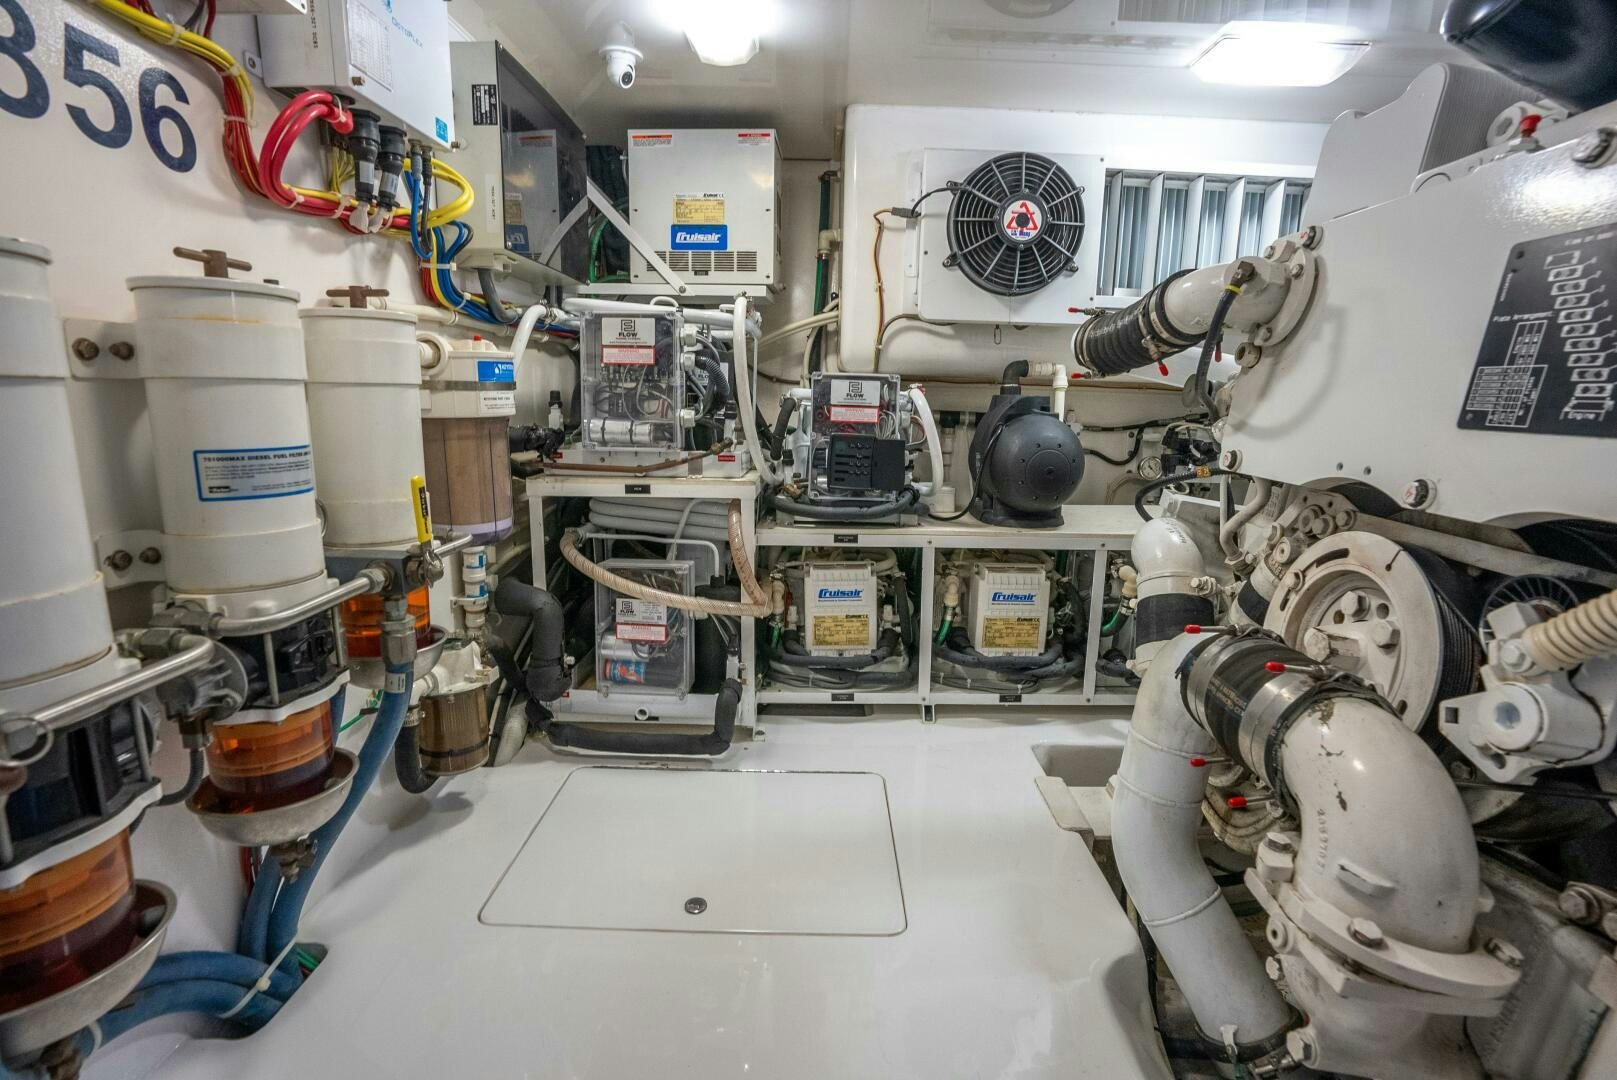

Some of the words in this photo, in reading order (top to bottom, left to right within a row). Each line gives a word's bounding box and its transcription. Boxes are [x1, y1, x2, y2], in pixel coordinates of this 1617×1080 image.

[676, 231, 721, 243] Cruisair
[818, 588, 864, 599] Cruisair
[991, 592, 1037, 602] Cruisair
